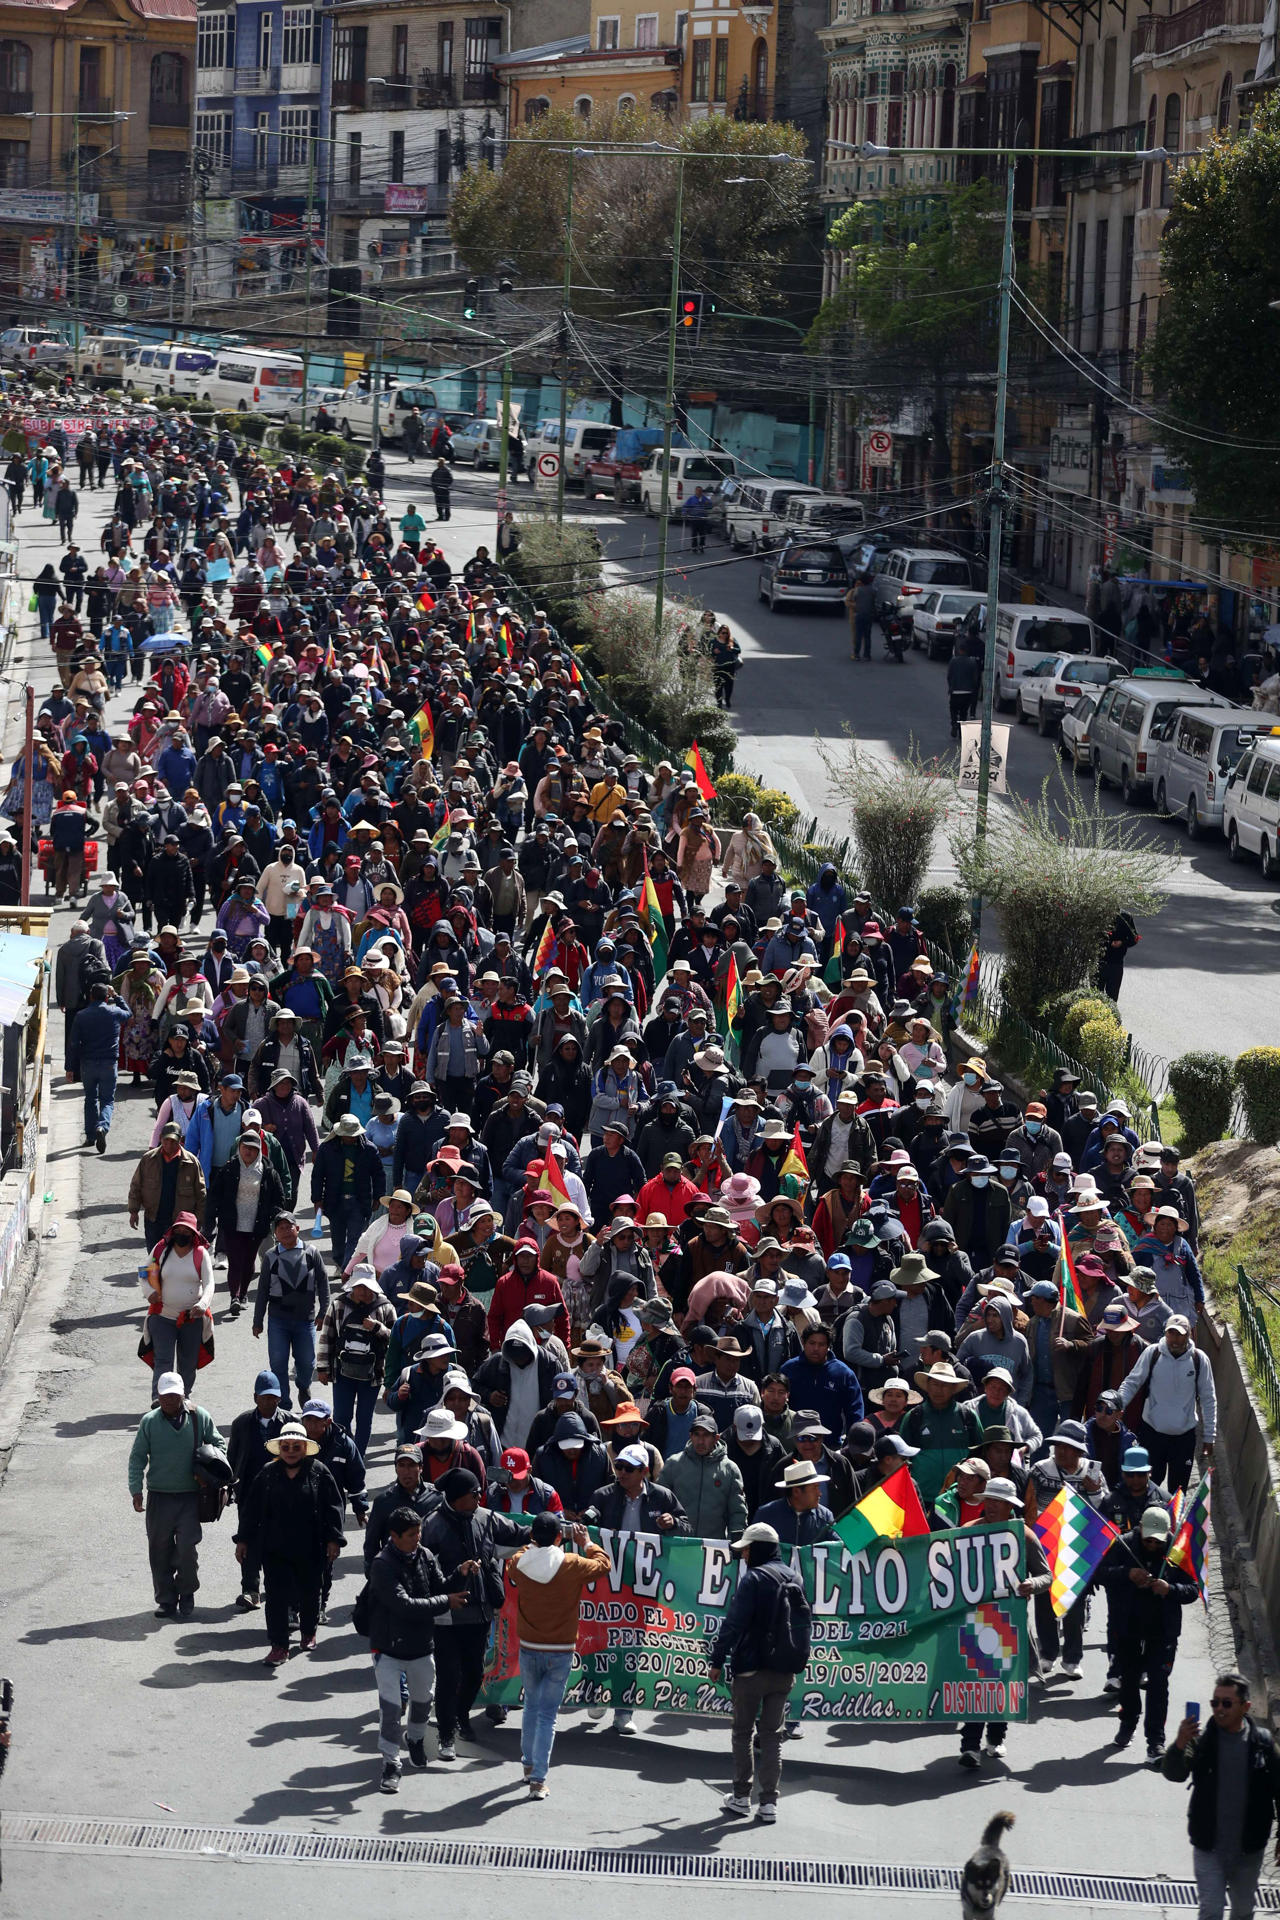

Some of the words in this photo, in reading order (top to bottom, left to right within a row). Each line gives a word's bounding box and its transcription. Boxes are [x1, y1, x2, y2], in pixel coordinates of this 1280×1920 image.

[506, 1455, 516, 1468] LA
[928, 1530, 1023, 1611] SUR
[643, 1606, 667, 1628] EL
[674, 1612, 697, 1634] 19
[703, 1614, 724, 1636] D
[811, 1621, 851, 1642] DEL
[859, 1619, 908, 1641] 2021
[804, 1663, 928, 1687] 19/05/2022
[622, 1677, 646, 1706] de
[653, 1679, 690, 1711] Pie
[943, 1681, 1006, 1715] DISTRITO
